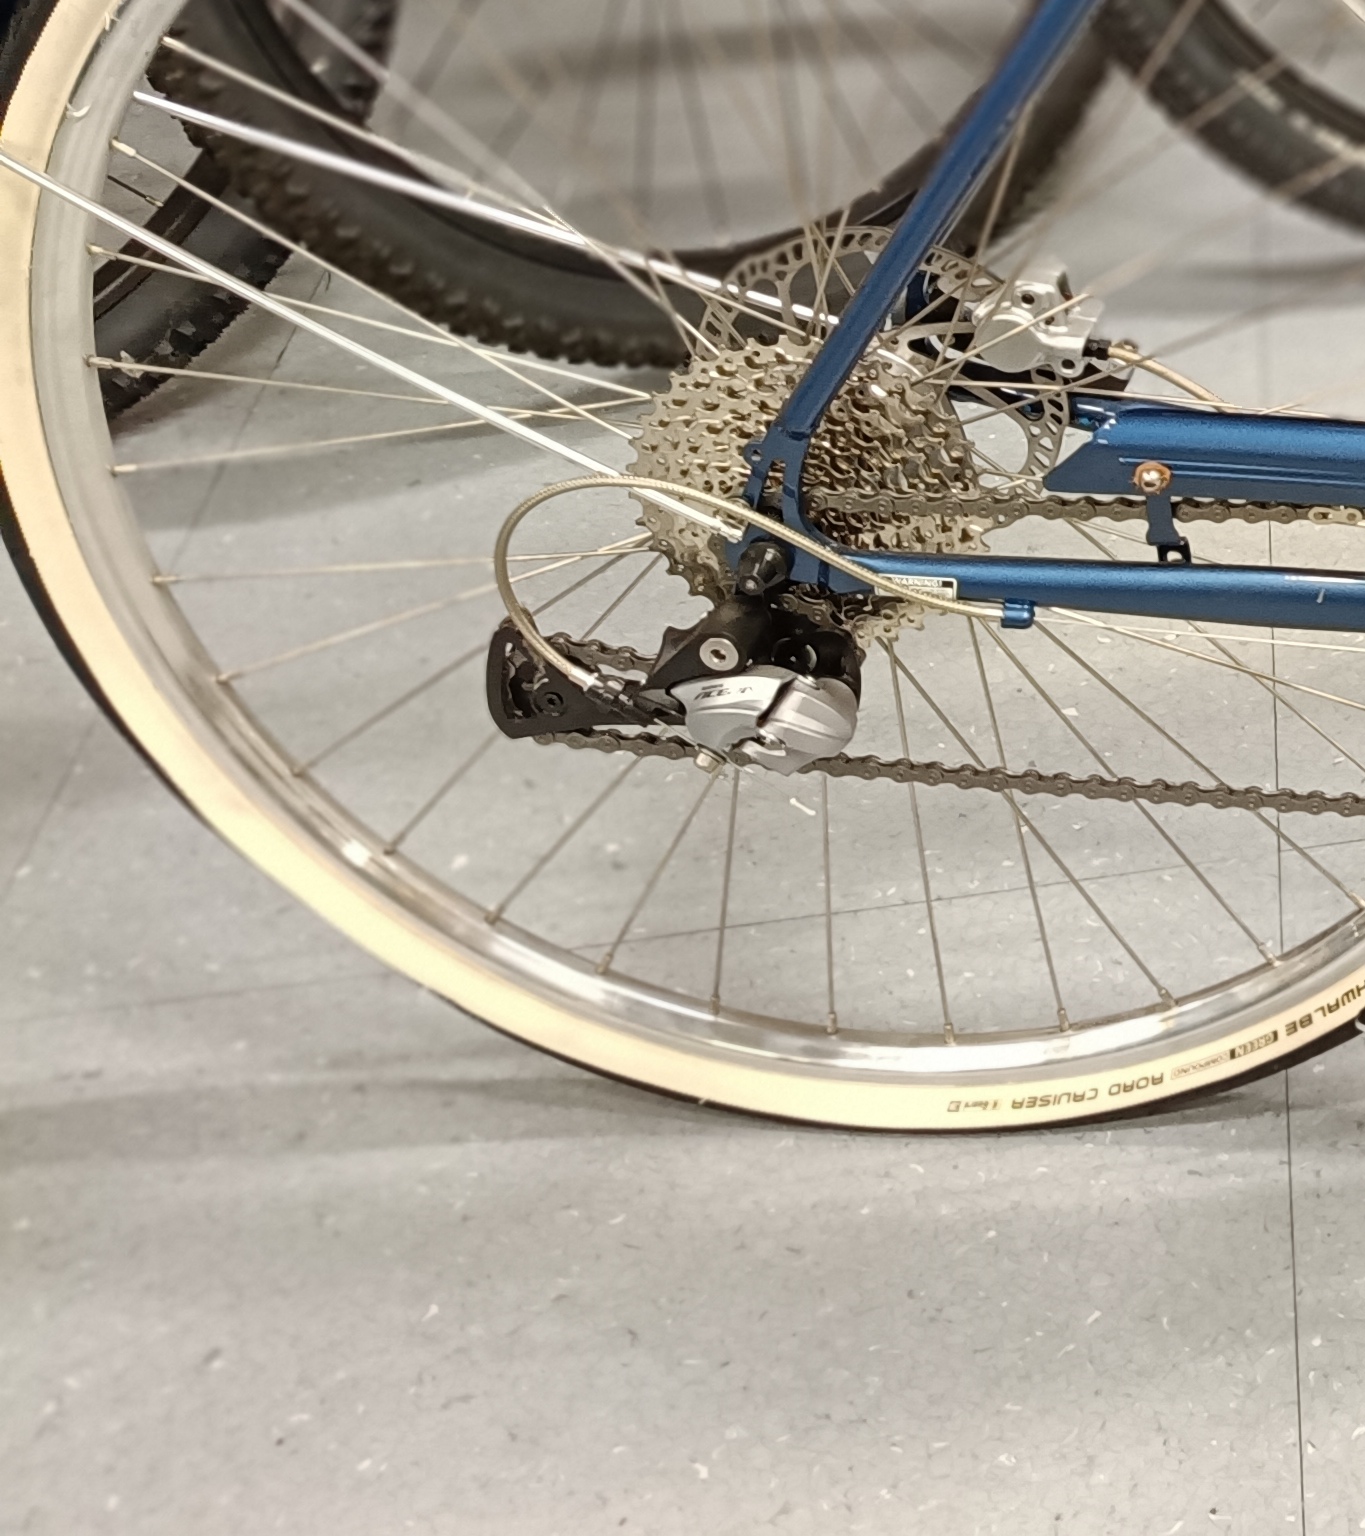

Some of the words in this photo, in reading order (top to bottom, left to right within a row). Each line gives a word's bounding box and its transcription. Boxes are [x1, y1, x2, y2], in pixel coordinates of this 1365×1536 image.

[1234, 1030, 1275, 1058] GREEN
[1108, 1072, 1164, 1096] ROAD
[1011, 1087, 1099, 1110] CRUISER
